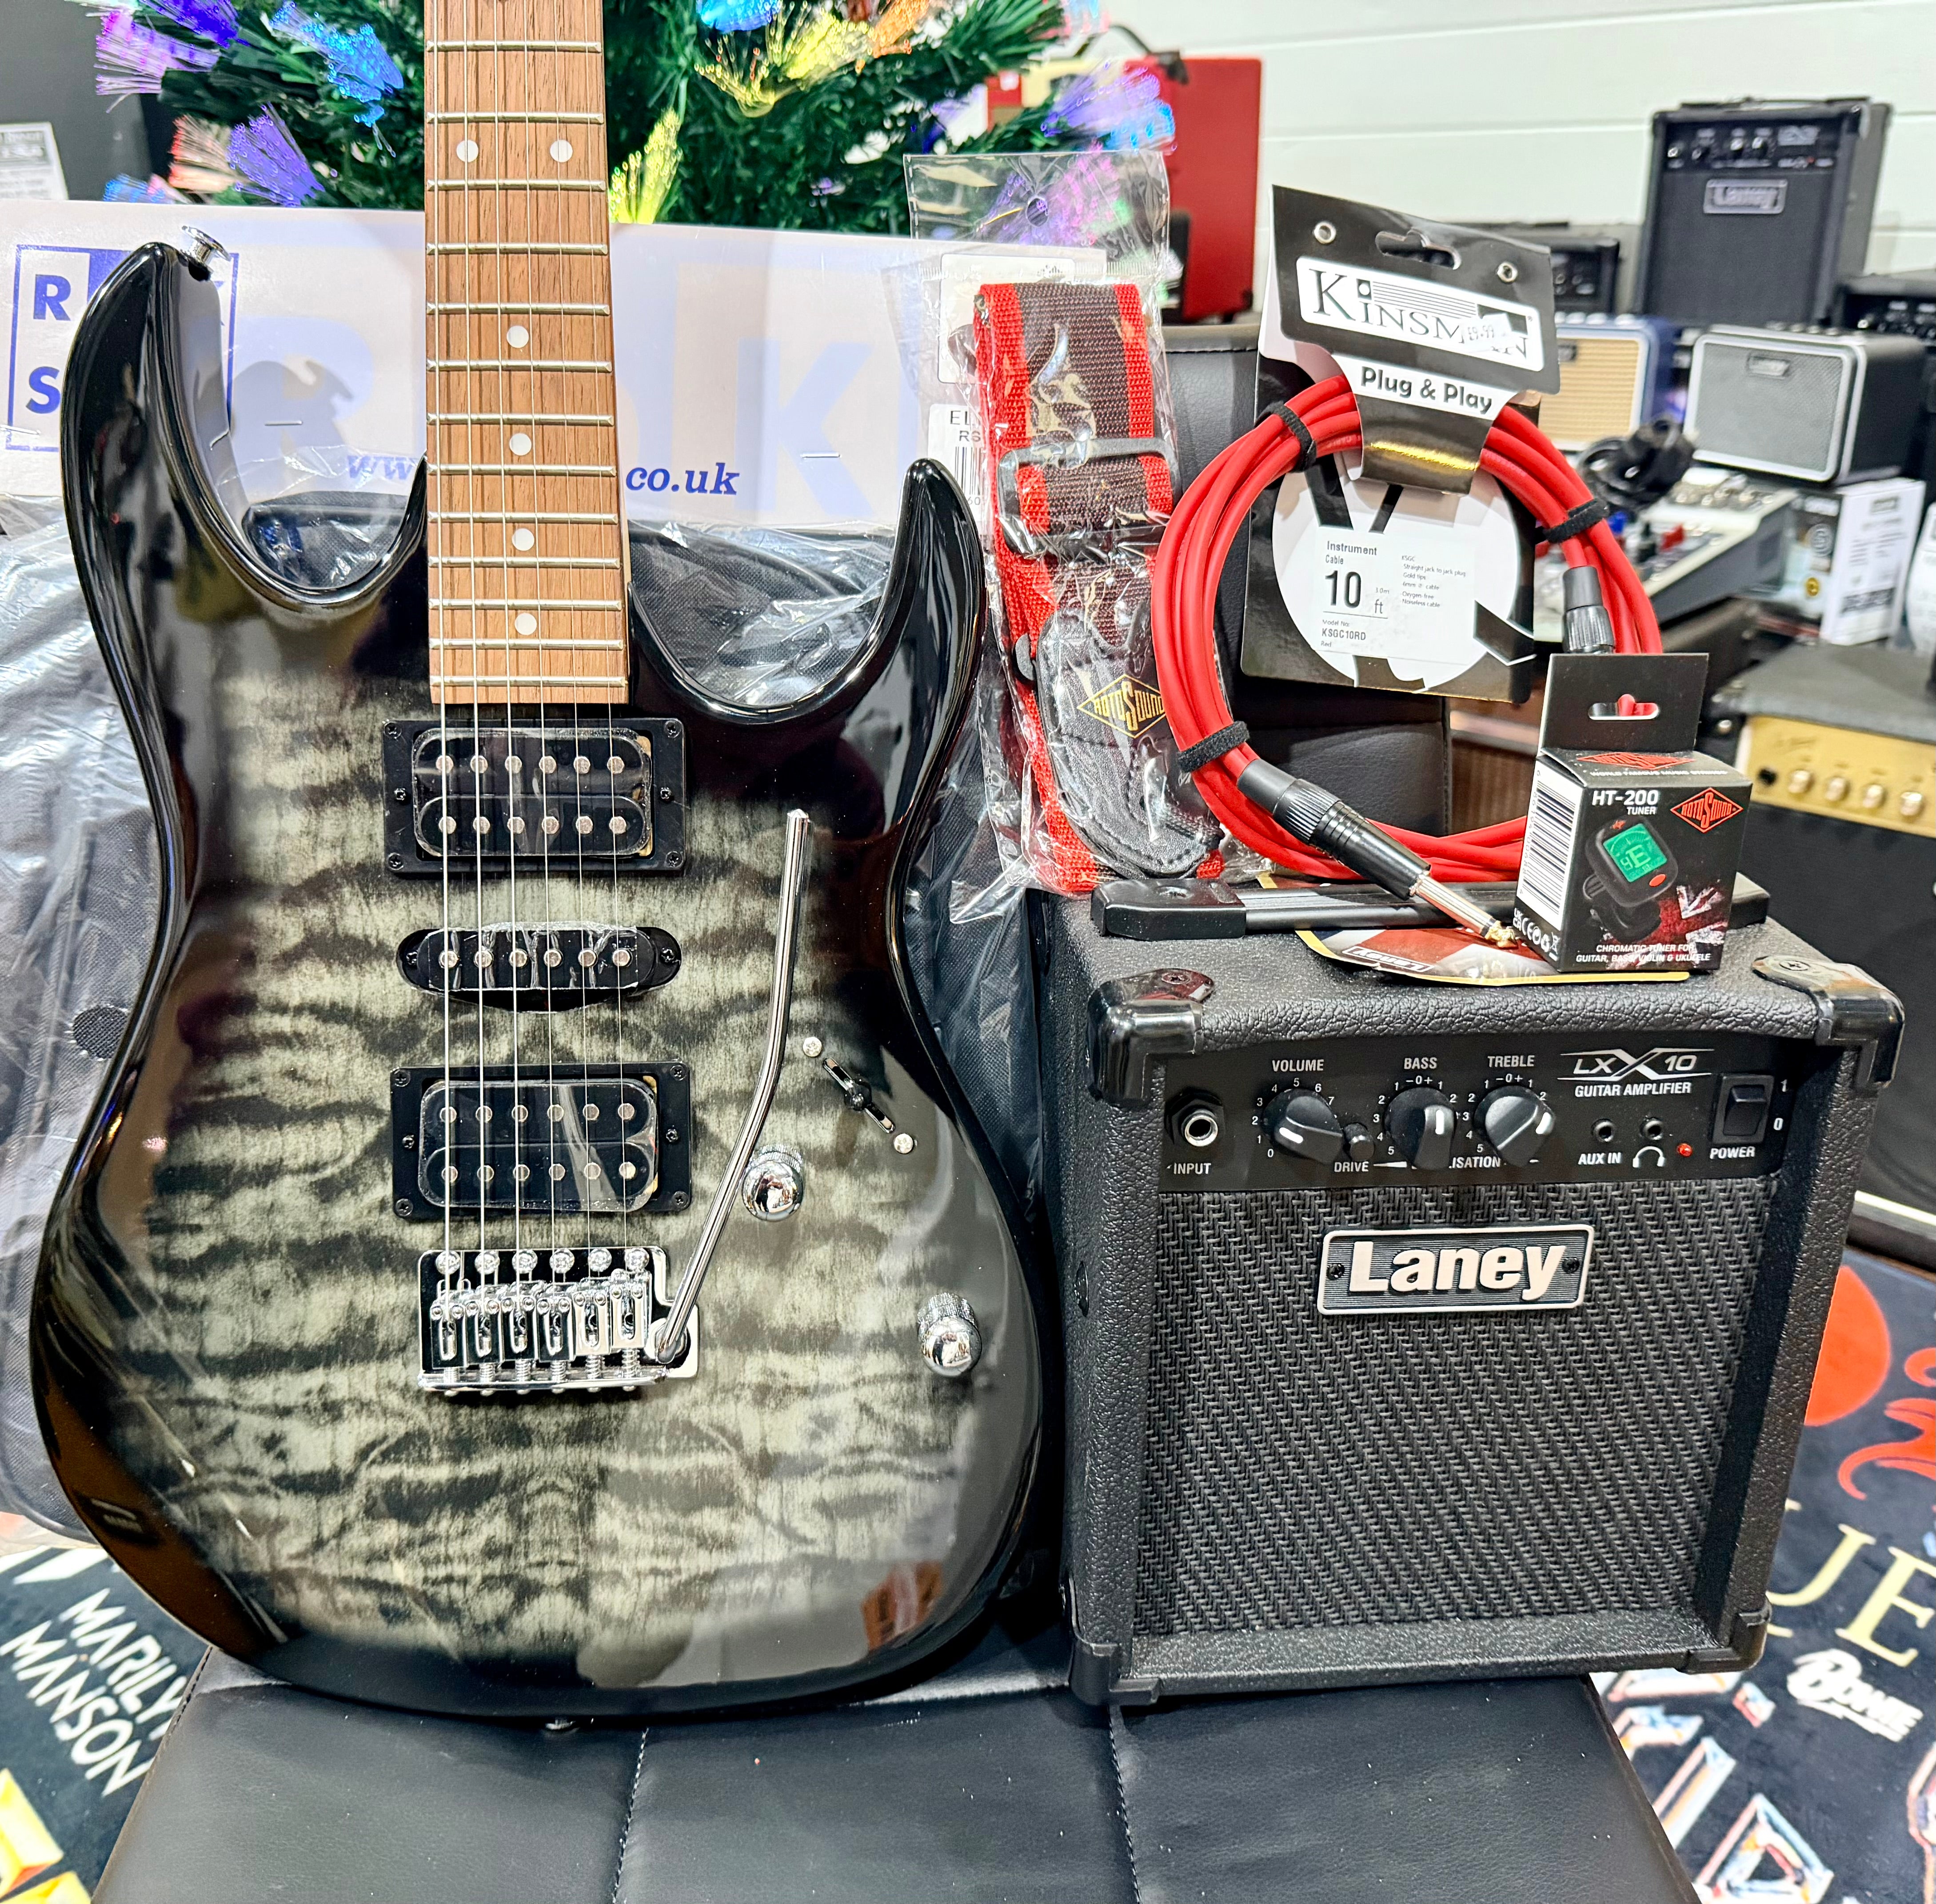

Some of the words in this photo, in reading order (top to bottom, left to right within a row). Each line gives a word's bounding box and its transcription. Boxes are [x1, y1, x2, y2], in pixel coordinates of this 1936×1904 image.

[1309, 268, 1528, 358] KINSMN
[1361, 366, 1412, 398] Plug
[1420, 379, 1435, 400] &
[1444, 383, 1492, 414] Play
[1327, 541, 1377, 555] Instrument
[1325, 555, 1344, 564] Cable
[1325, 570, 1361, 608] 10
[1375, 599, 1383, 614] ft
[1322, 628, 1366, 640] KSGC10RD
[1592, 790, 1659, 805] HT-200
[1627, 807, 1657, 815] TUNER
[1625, 844, 1651, 868] E
[1596, 944, 1647, 952] CHROMATIC
[1649, 944, 1676, 952] TUNER
[1576, 955, 1609, 963] GUITAR,
[1639, 954, 1665, 962] VIOLIN
[1676, 953, 1711, 961] UKULELE
[1404, 1057, 1437, 1069] BASS
[1488, 1055, 1535, 1067] TREBLE
[1272, 1060, 1324, 1072] VOLUME
[1293, 1078, 1300, 1087] 5
[1395, 1082, 1399, 1091] 1
[1438, 1081, 1443, 1089] 1
[1485, 1080, 1489, 1089] 1
[1529, 1079, 1533, 1088] 1
[1272, 1084, 1277, 1092] 4
[1315, 1083, 1321, 1092] 6
[1575, 1084, 1621, 1097] GUITAR
[1623, 1082, 1692, 1096] AMPLIFIER
[1328, 1096, 1334, 1105] 7
[1378, 1095, 1385, 1104] 2
[1449, 1094, 1457, 1103] 2
[1468, 1093, 1476, 1102] 2
[1540, 1092, 1546, 1100] 2
[1257, 1098, 1263, 1106] 3
[1252, 1116, 1258, 1125] 2
[1373, 1114, 1380, 1123] 3
[1462, 1112, 1469, 1121] 3
[1257, 1135, 1261, 1144] 1
[1377, 1132, 1383, 1141] 4
[1466, 1131, 1472, 1139] 4
[1267, 1148, 1274, 1157] 0
[1388, 1146, 1394, 1155] 5
[1477, 1144, 1484, 1152] 5
[1710, 1147, 1755, 1160] POWER
[1449, 1156, 1501, 1169] ISATION
[1578, 1153, 1605, 1165] AUX
[1607, 1153, 1621, 1164] IN
[1174, 1163, 1211, 1175] INPUT
[1334, 1161, 1369, 1172] DRIVE
[1349, 1241, 1566, 1301] Laney
[0, 1620, 154, 1798] MANSON
